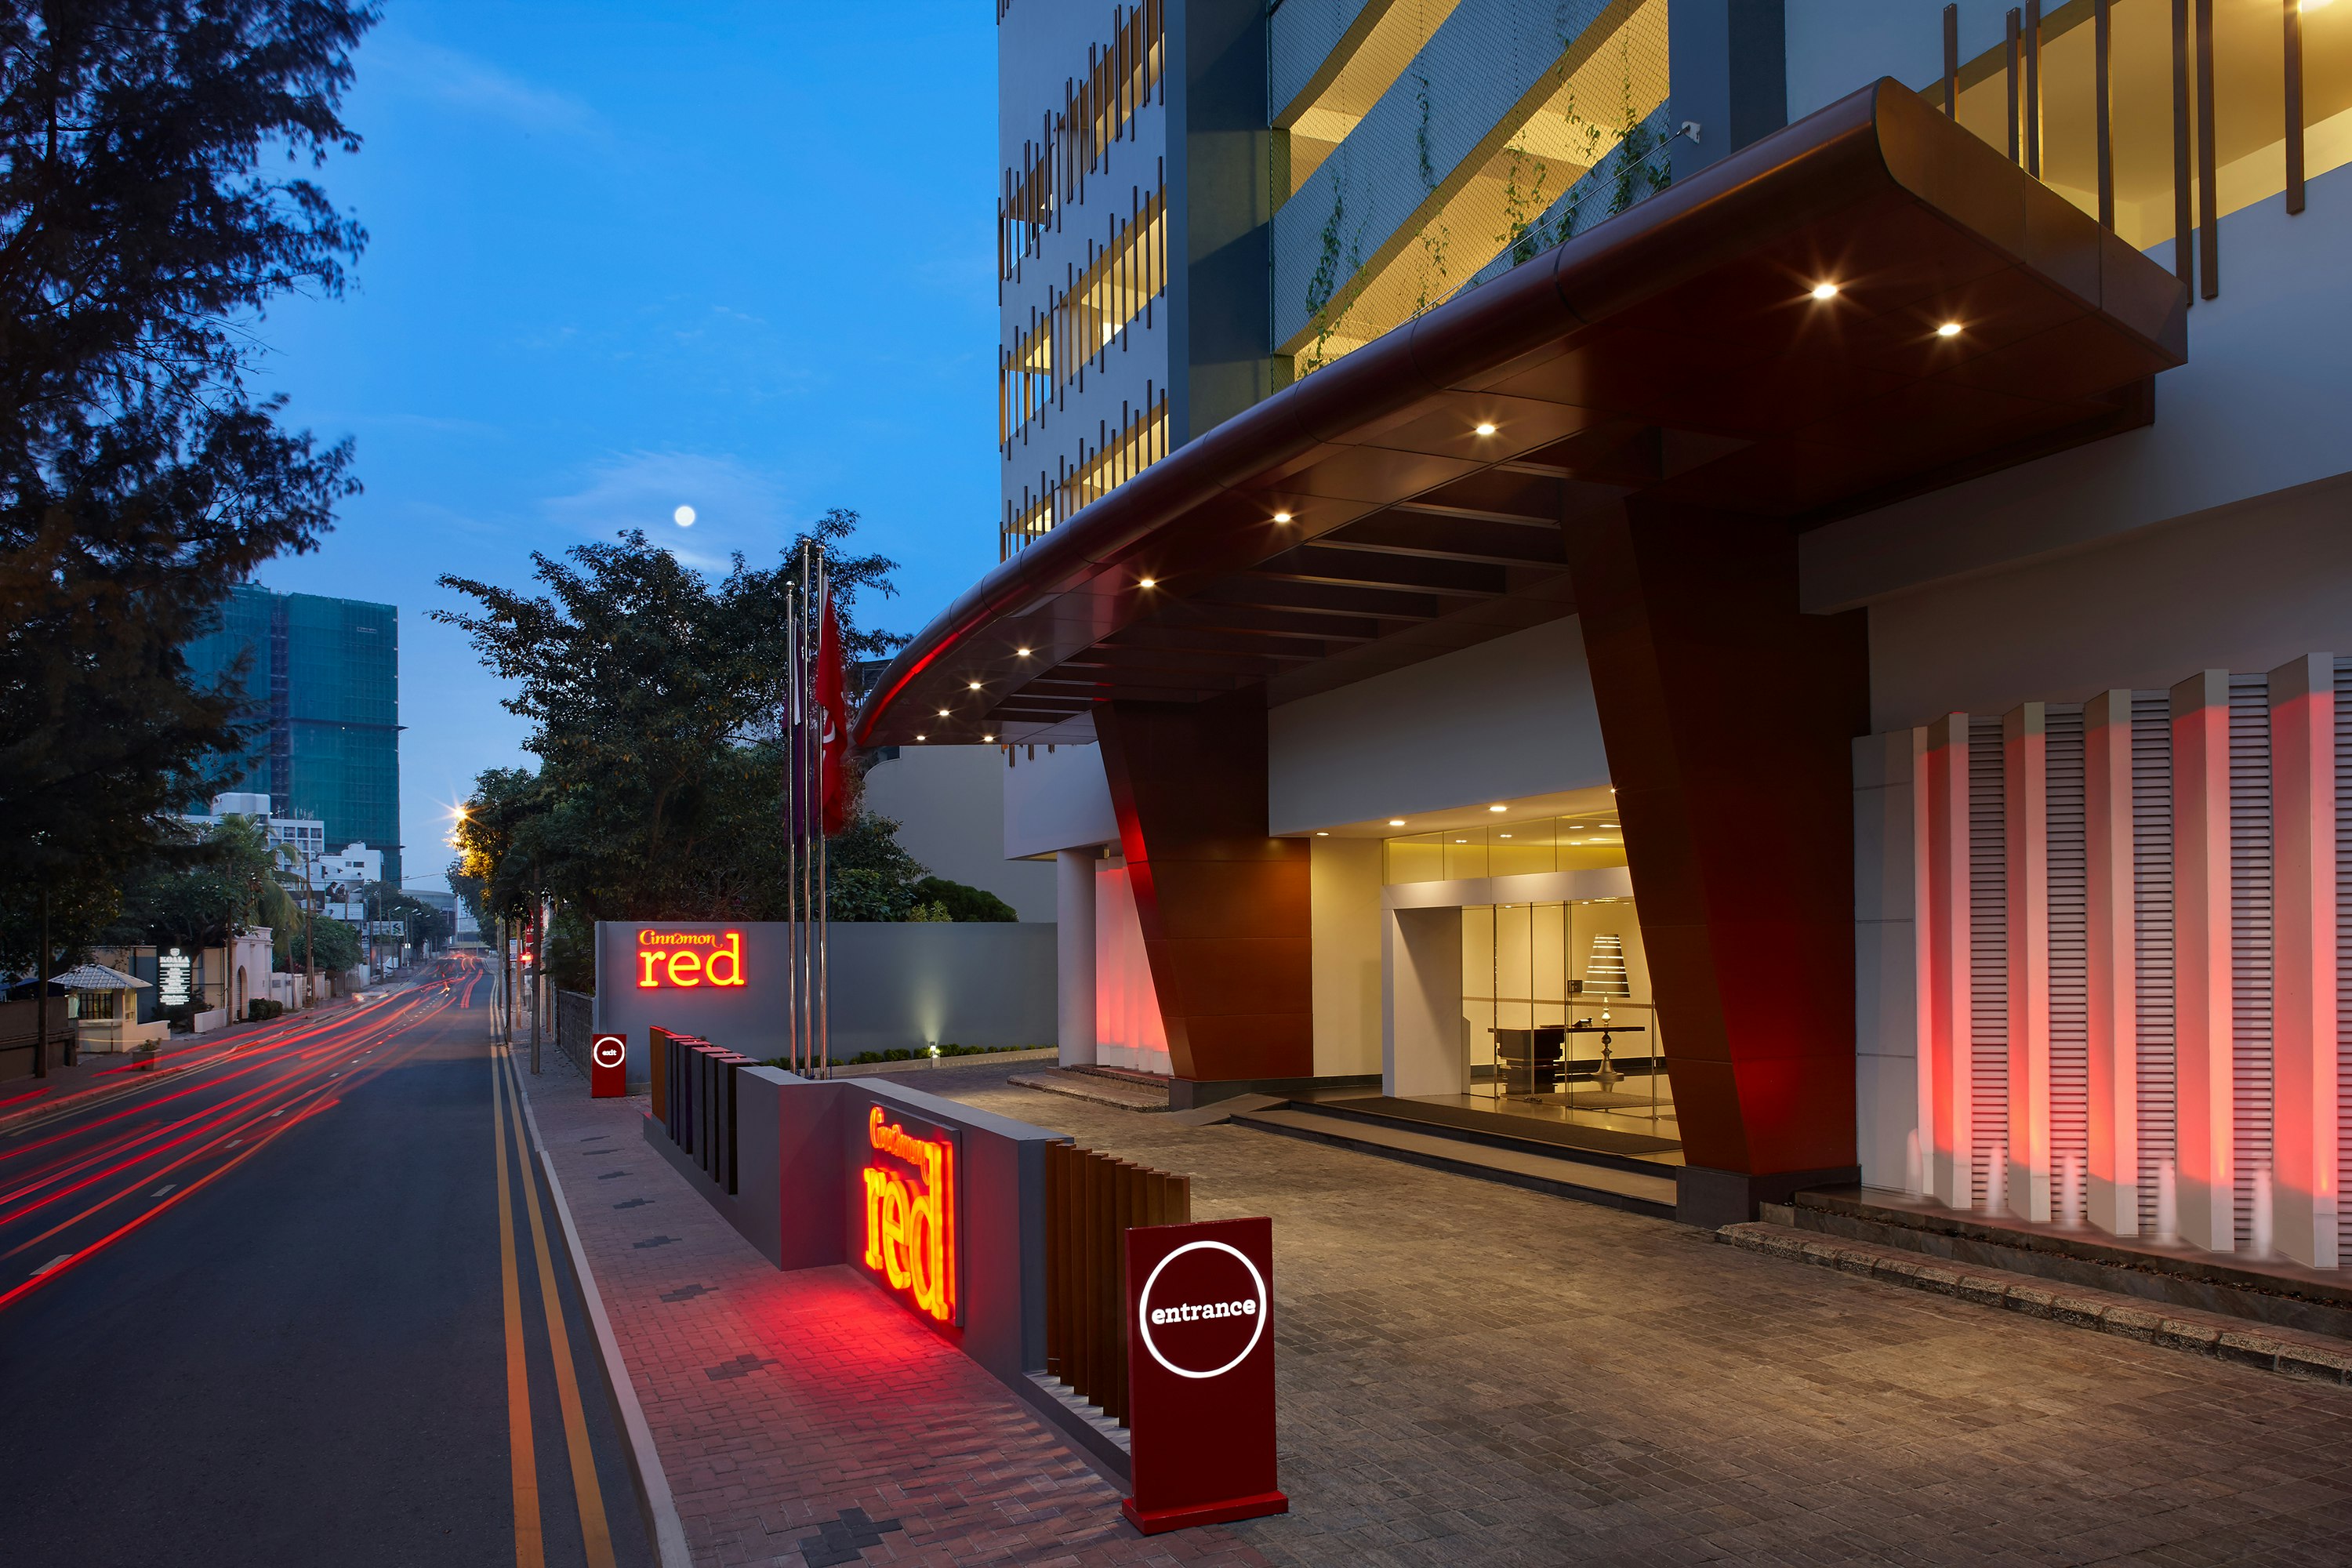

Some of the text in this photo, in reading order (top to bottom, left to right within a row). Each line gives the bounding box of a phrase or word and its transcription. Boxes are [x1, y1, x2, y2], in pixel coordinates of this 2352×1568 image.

[640, 929, 724, 949] Cinnamon
[640, 933, 745, 987] red
[863, 1142, 949, 1320] red
[1151, 1299, 1256, 1325] entrance
